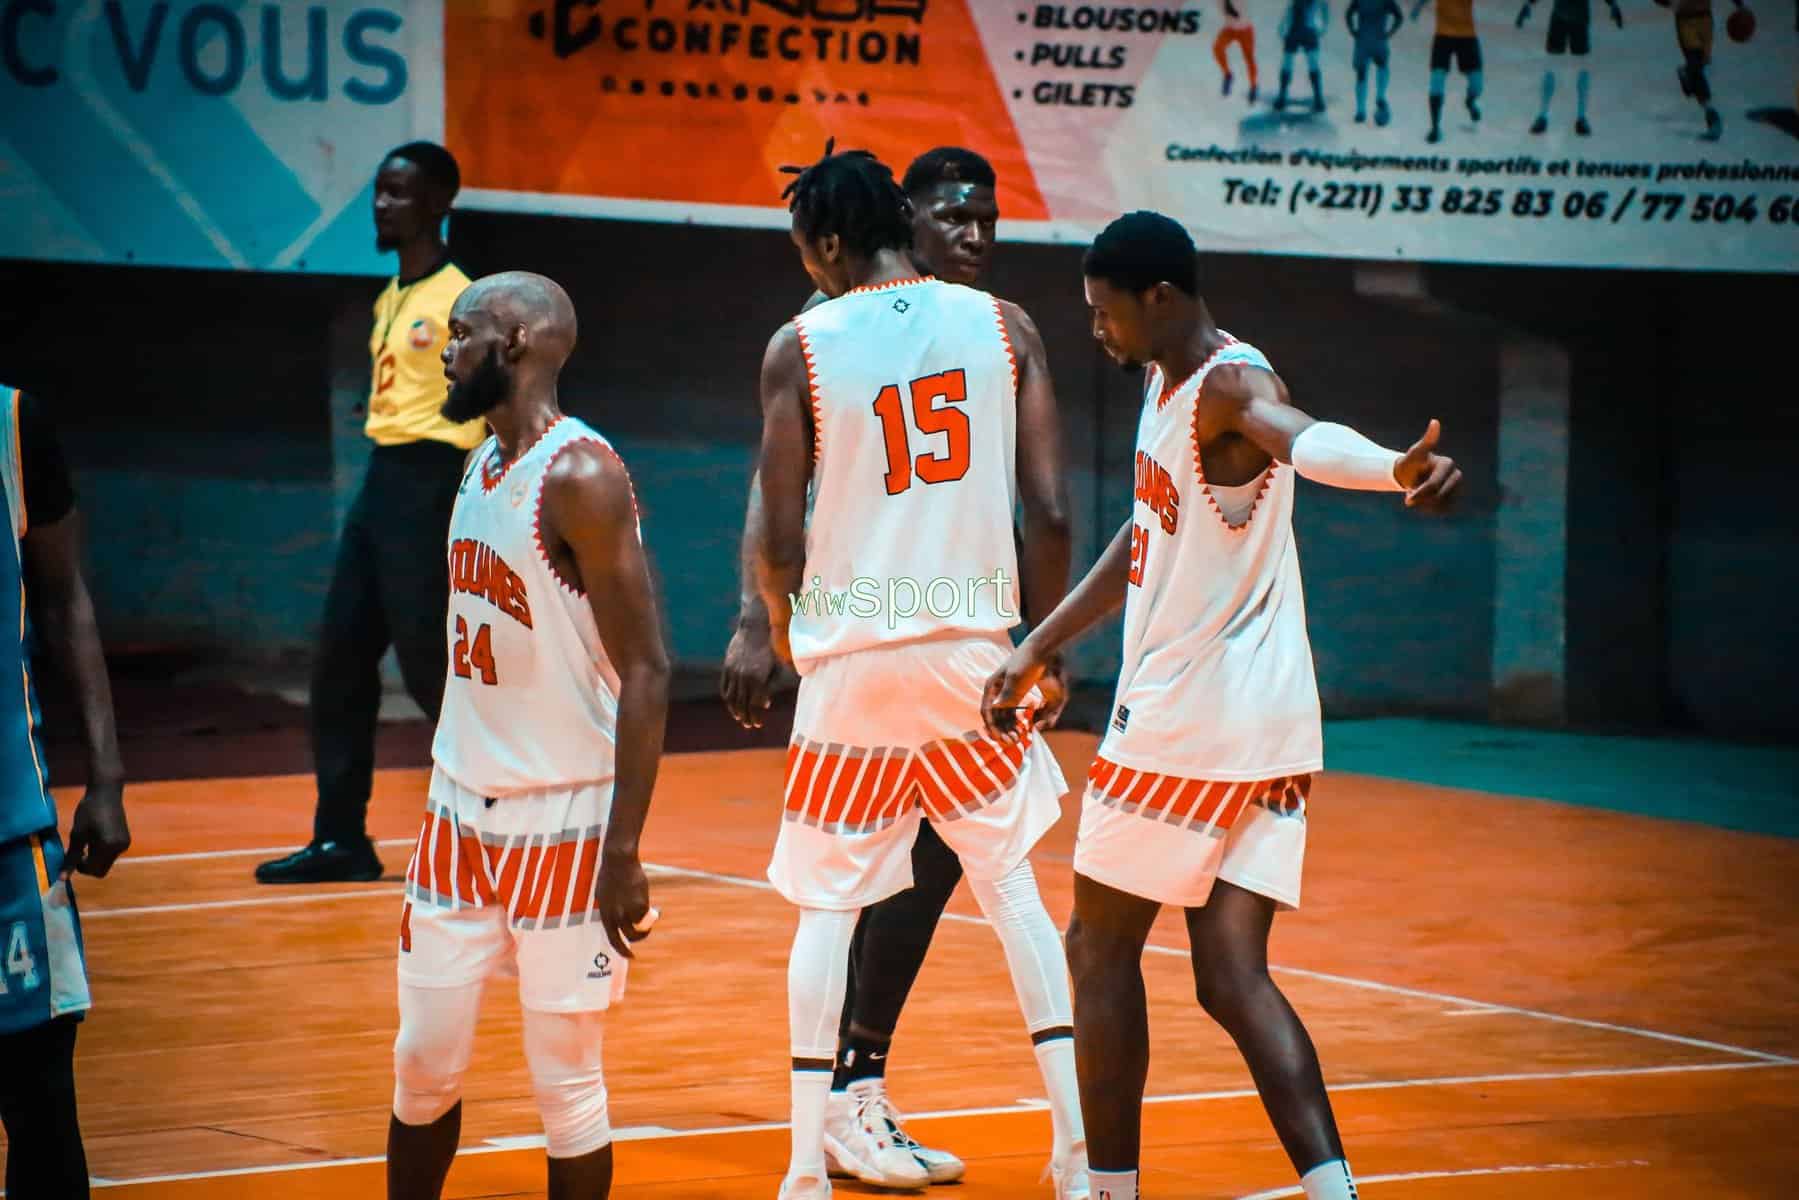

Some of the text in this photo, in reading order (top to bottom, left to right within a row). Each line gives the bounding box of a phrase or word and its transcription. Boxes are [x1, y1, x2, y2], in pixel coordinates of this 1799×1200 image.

[612, 17, 922, 66] CONFECTION
[1033, 5, 1201, 34] BLOUSONS
[1030, 43, 1127, 69] PULLS
[1032, 81, 1136, 108] GILETS
[1457, 156, 1542, 176] sportifs
[1547, 160, 1571, 176] et
[1576, 160, 1652, 179] tenues
[1223, 178, 1282, 206] Tel:
[1289, 180, 1384, 218] (+221)
[1392, 186, 1433, 213] 33
[1440, 186, 1504, 216] 825
[1511, 189, 1555, 217] 83
[1563, 191, 1608, 219] 06
[1642, 193, 1685, 221] 77
[1691, 193, 1759, 223] 504
[872, 368, 972, 496] 15
[1128, 523, 1150, 589] 21
[453, 613, 499, 686] 24
